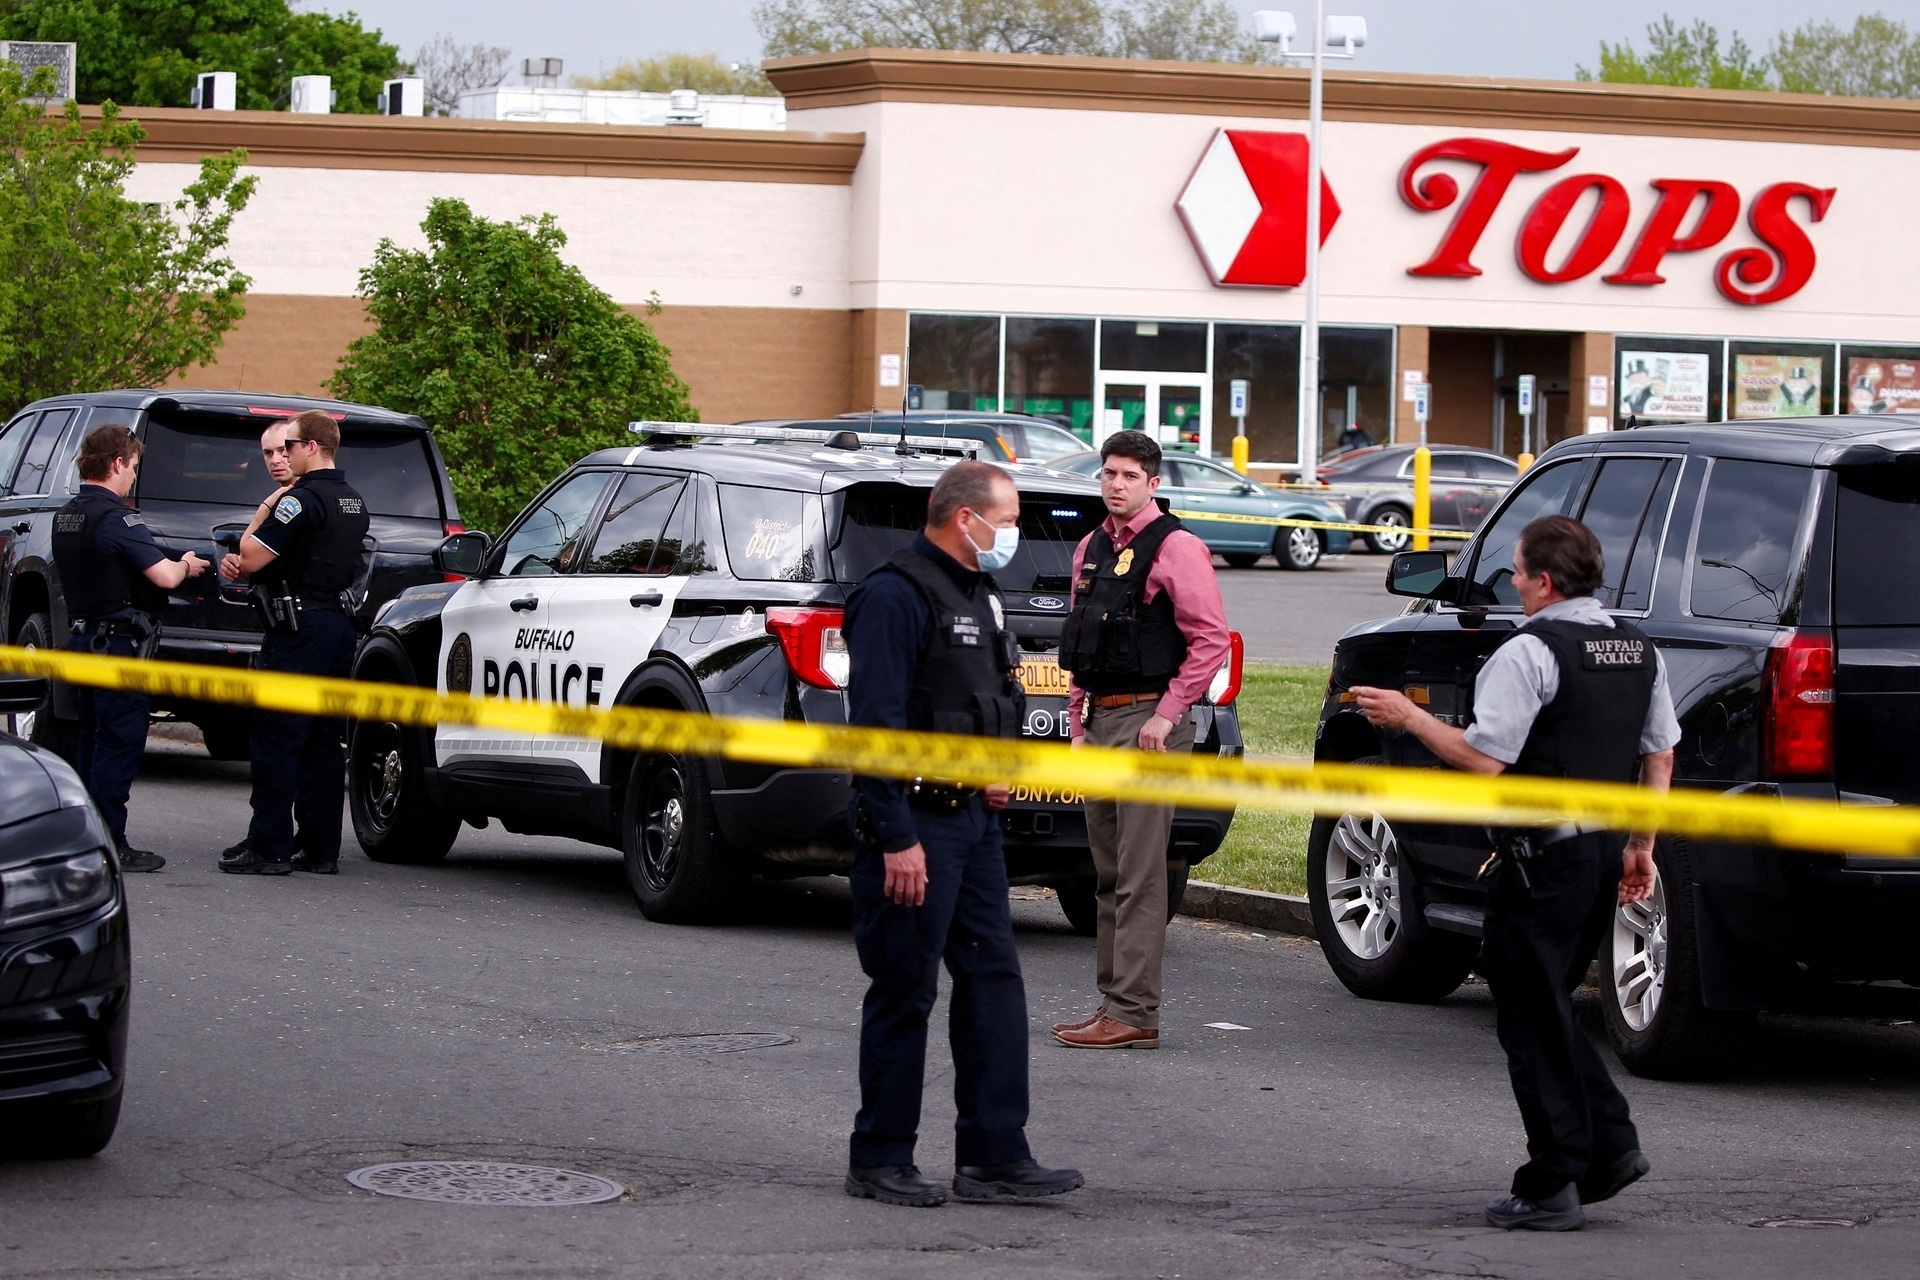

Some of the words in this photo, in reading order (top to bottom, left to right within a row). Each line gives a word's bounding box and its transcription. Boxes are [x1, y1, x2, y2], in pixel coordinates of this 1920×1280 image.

[745, 532, 780, 560] 040
[514, 628, 575, 652] BUFFALO
[1584, 640, 1644, 652] BUFFALO
[1594, 652, 1643, 665] POLICE
[483, 659, 605, 706] POLICE
[1018, 664, 1068, 688] POLICE
